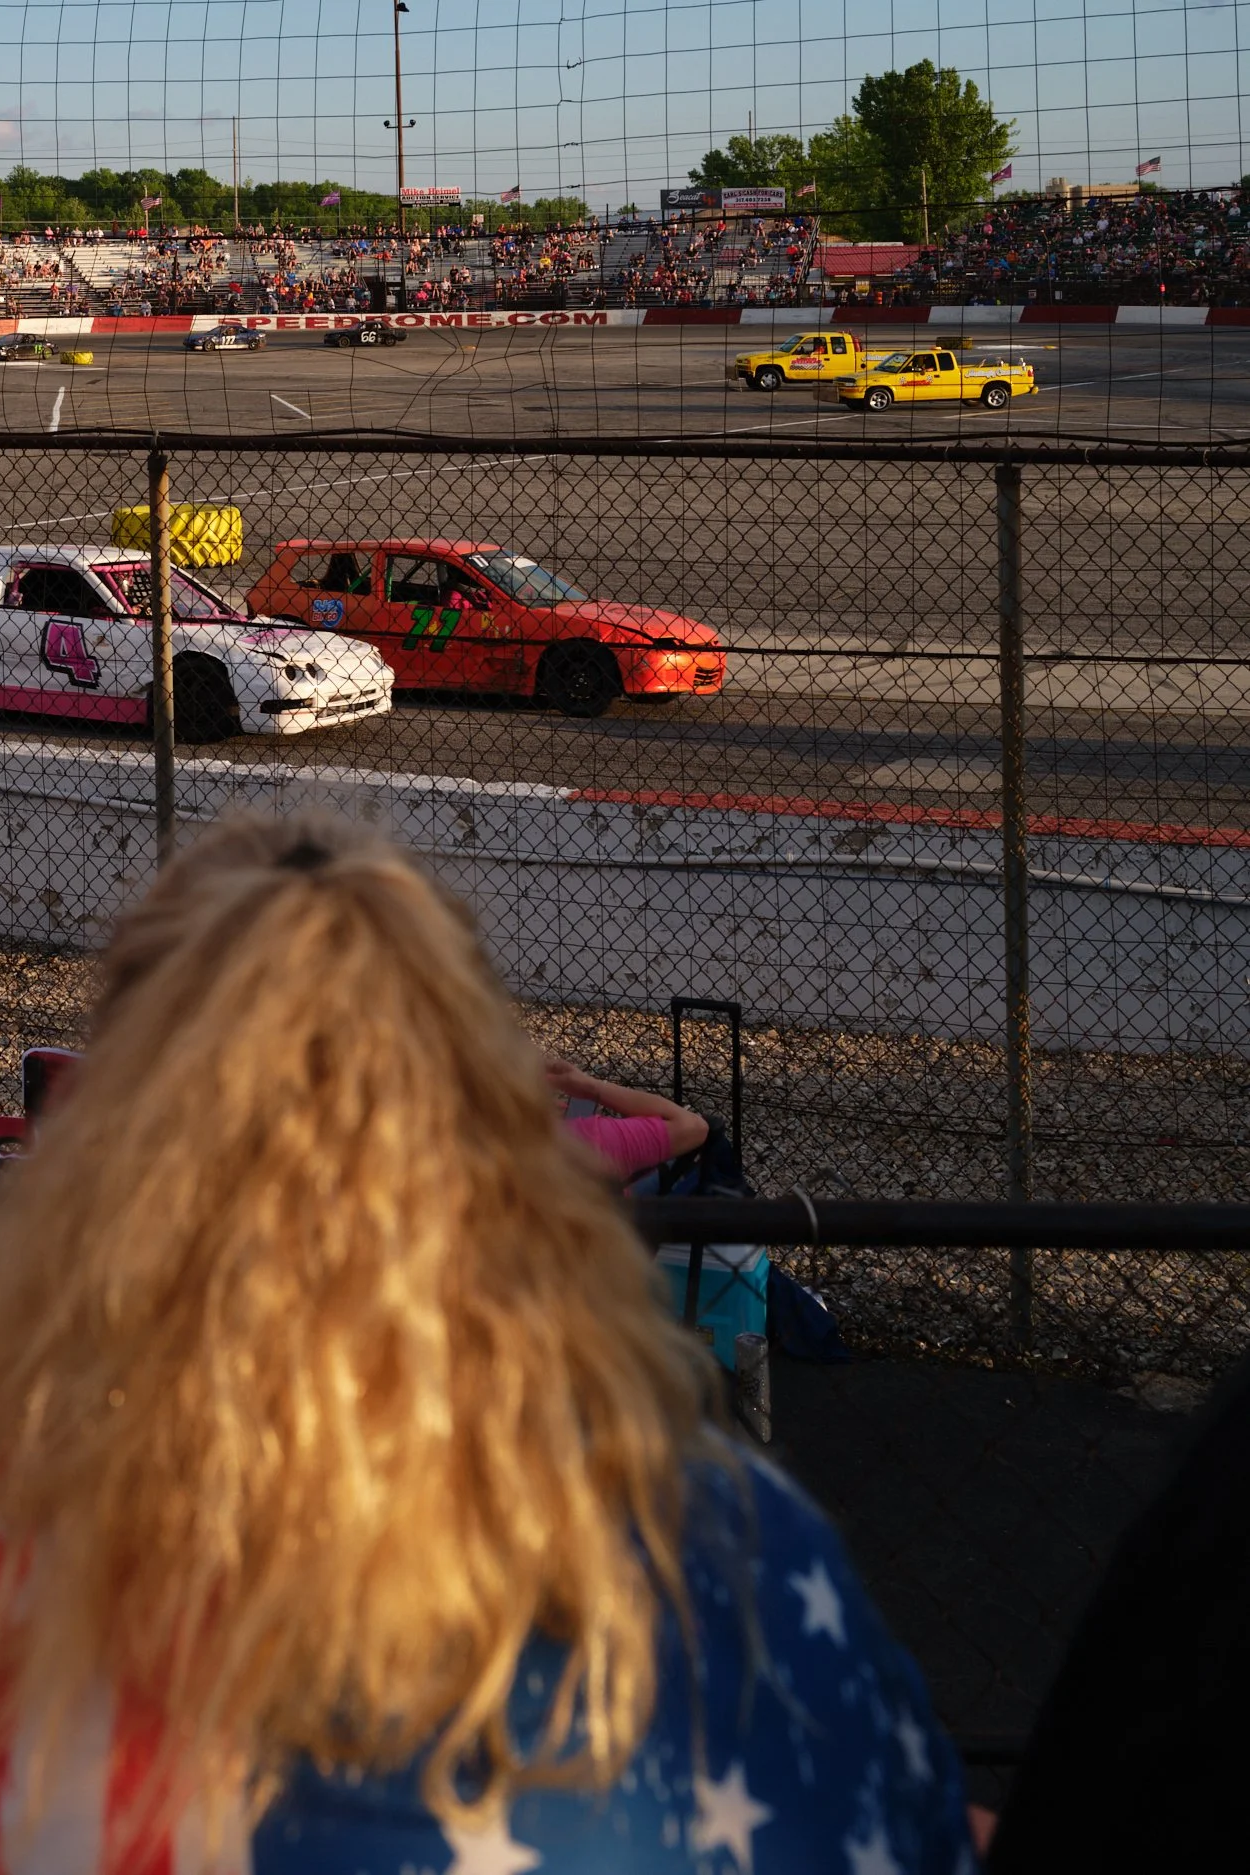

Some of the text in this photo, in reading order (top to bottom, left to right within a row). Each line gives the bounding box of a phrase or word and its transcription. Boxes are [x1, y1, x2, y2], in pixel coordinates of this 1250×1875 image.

[401, 187, 460, 196] Mike Heimel
[742, 189, 757, 197] CASH
[769, 190, 783, 198] CARS
[218, 312, 607, 330] SPEEDROME.COM
[361, 331, 376, 342] 66
[42, 619, 101, 688] 4
